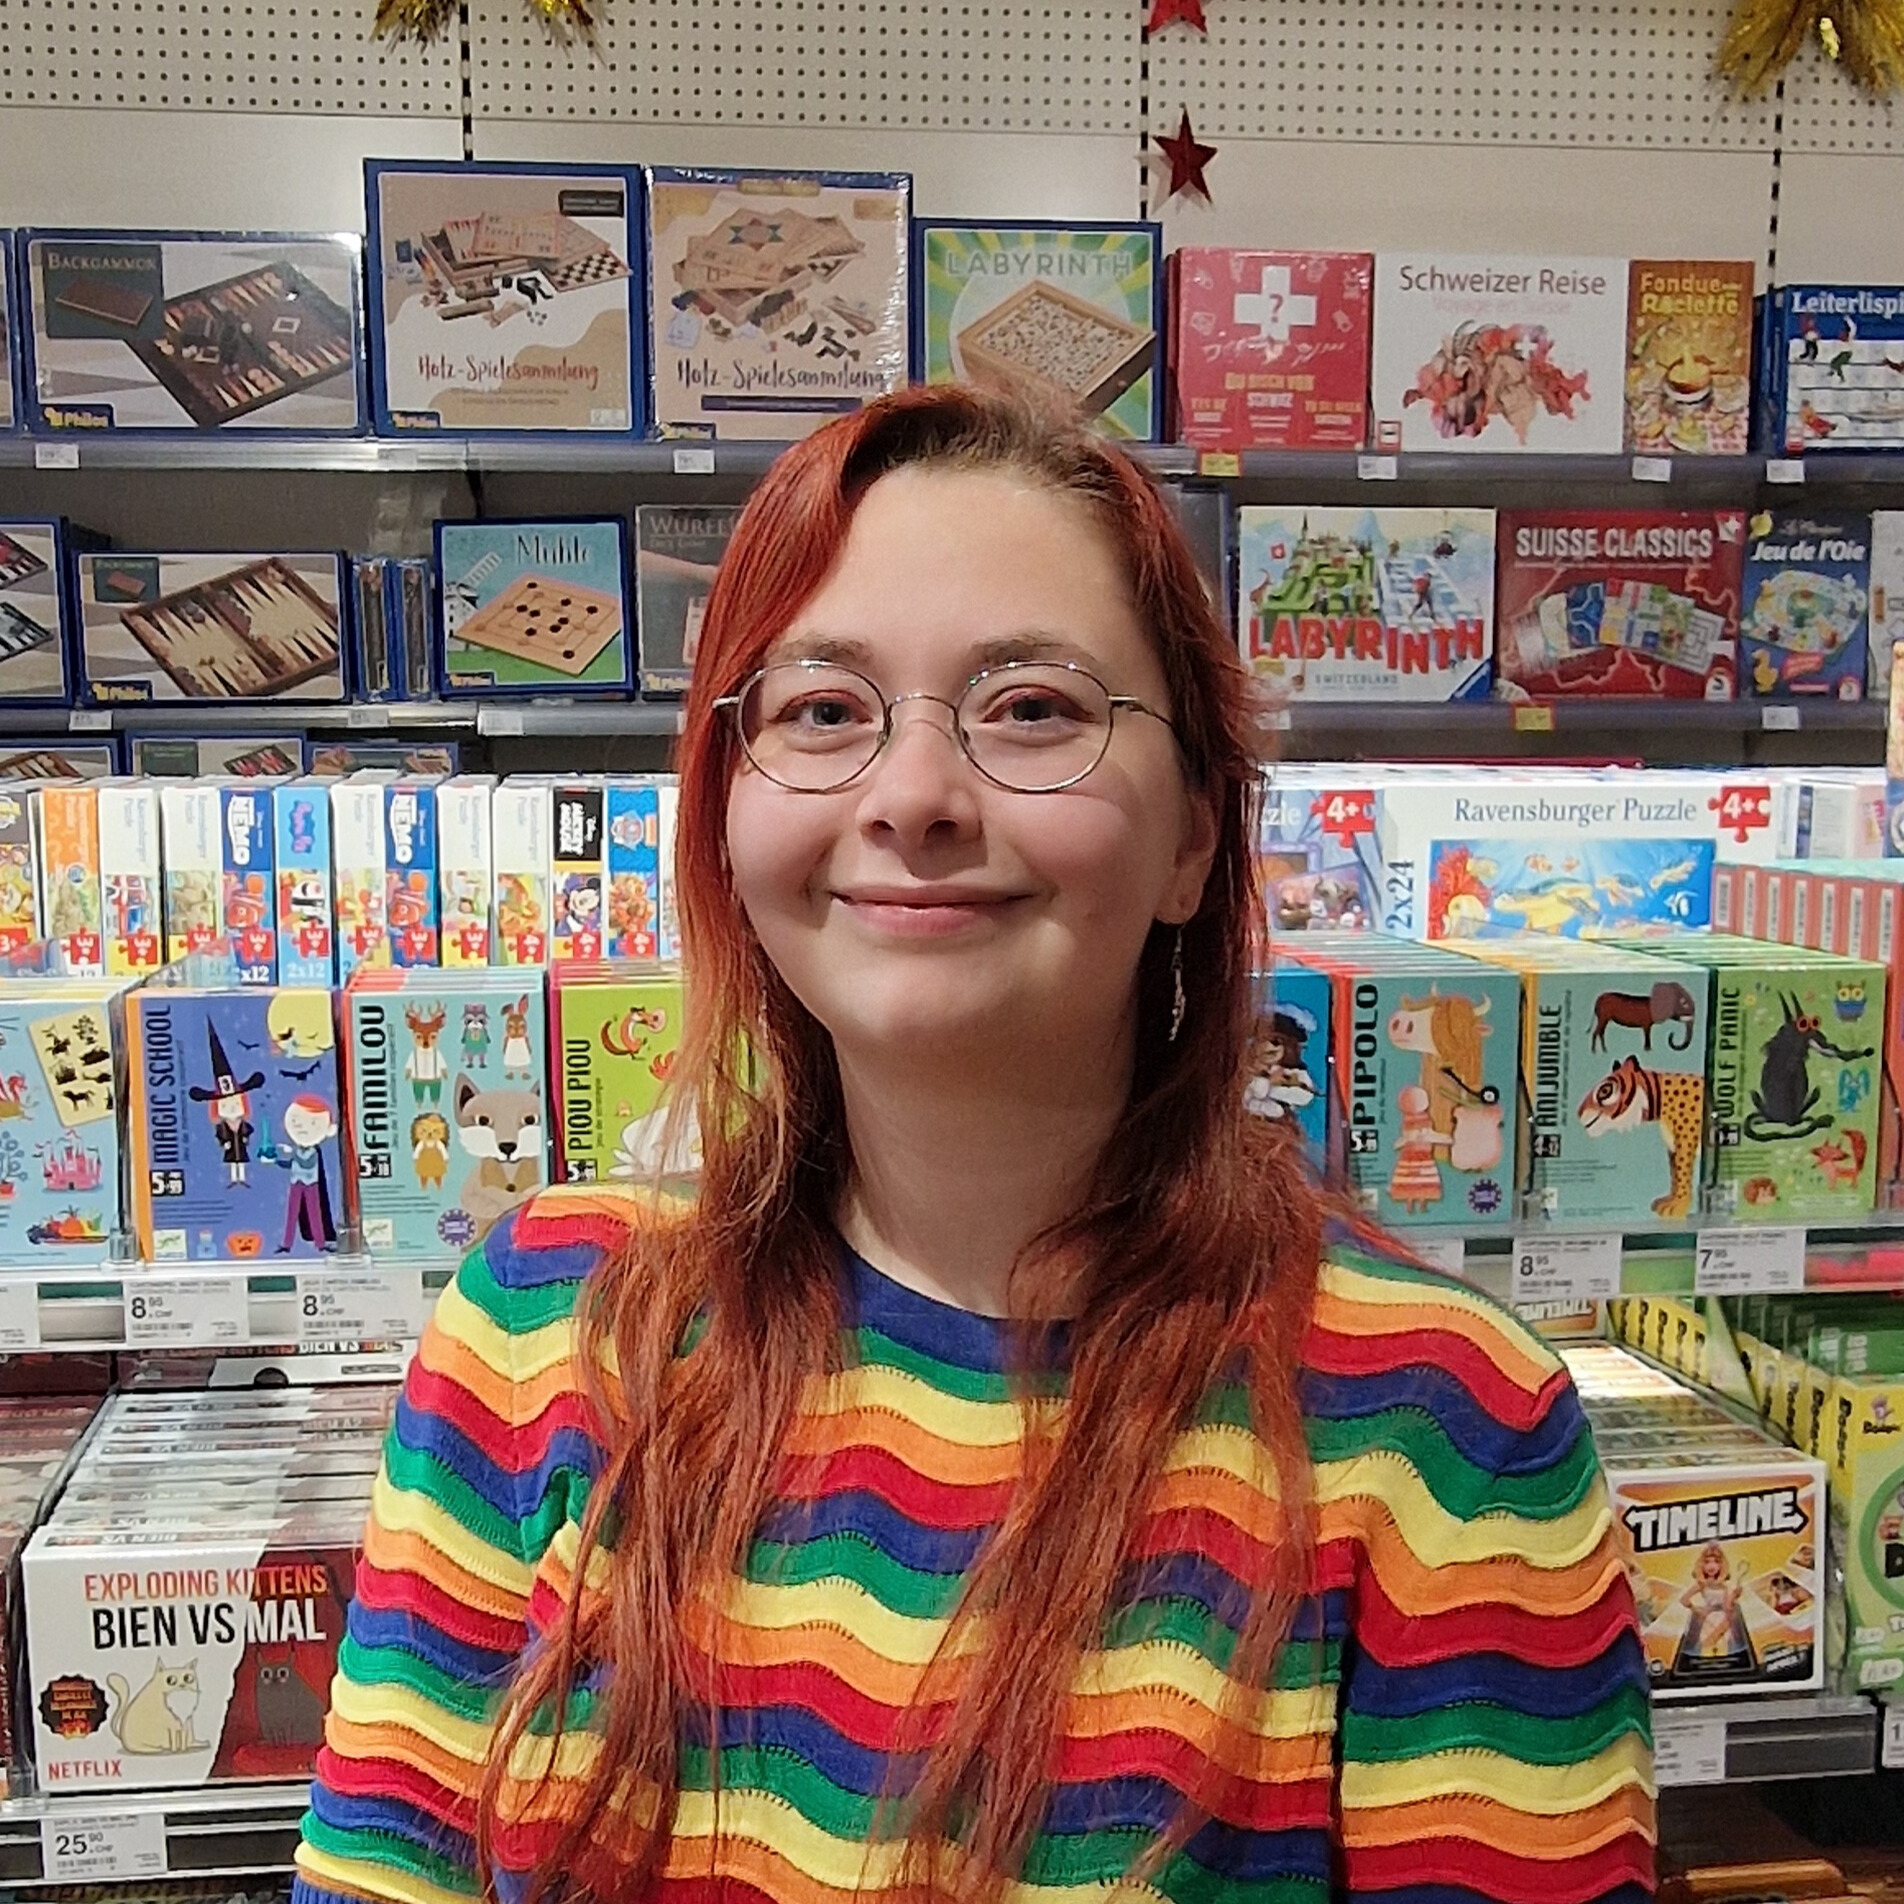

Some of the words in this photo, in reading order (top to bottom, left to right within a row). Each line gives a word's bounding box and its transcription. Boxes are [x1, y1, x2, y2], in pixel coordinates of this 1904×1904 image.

[945, 249, 1134, 278] LABYRINTH
[1400, 265, 1531, 294] Schweizer
[1538, 268, 1606, 295] Reise
[1640, 272, 1722, 294] Fondue
[418, 354, 600, 391] Holz-Spielesammlung
[1516, 526, 1599, 558] SUISSE
[1604, 526, 1713, 558] CLASSICS
[1750, 540, 1788, 562] Jeu
[1789, 540, 1817, 562] de
[1249, 617, 1484, 674] LABYRINTH
[1326, 795, 1360, 823] 4+
[1453, 796, 1616, 828] Ravensburger
[1623, 796, 1697, 823] Puzzle
[1722, 793, 1755, 820] 4+
[1385, 859, 1415, 930] 2x24
[287, 962, 325, 978] 2x12
[1720, 986, 1741, 1051] PANIC
[144, 1005, 175, 1087] SCHOOL
[1353, 984, 1379, 1125] PIPOLO
[359, 1005, 389, 1150] FAMILOU
[566, 1040, 592, 1090] PIOU
[1536, 1004, 1562, 1126] ANIJUMBLE
[1716, 1061, 1736, 1118] WOLF
[150, 1093, 179, 1165] MAGIC
[567, 1099, 593, 1150] PIOU
[1520, 1256, 1534, 1276] 8
[1699, 1249, 1713, 1269] 7
[131, 1297, 147, 1319] 8
[303, 1294, 318, 1316] 8
[1626, 1490, 1805, 1549] TIMELINE
[84, 1568, 220, 1602] EXPLODING
[226, 1564, 329, 1598] KITTENS
[92, 1604, 178, 1650] BIEN
[187, 1602, 236, 1645] VS
[243, 1597, 327, 1645] MAL
[48, 1759, 122, 1781] NETFLIX
[56, 1834, 87, 1856] 25
